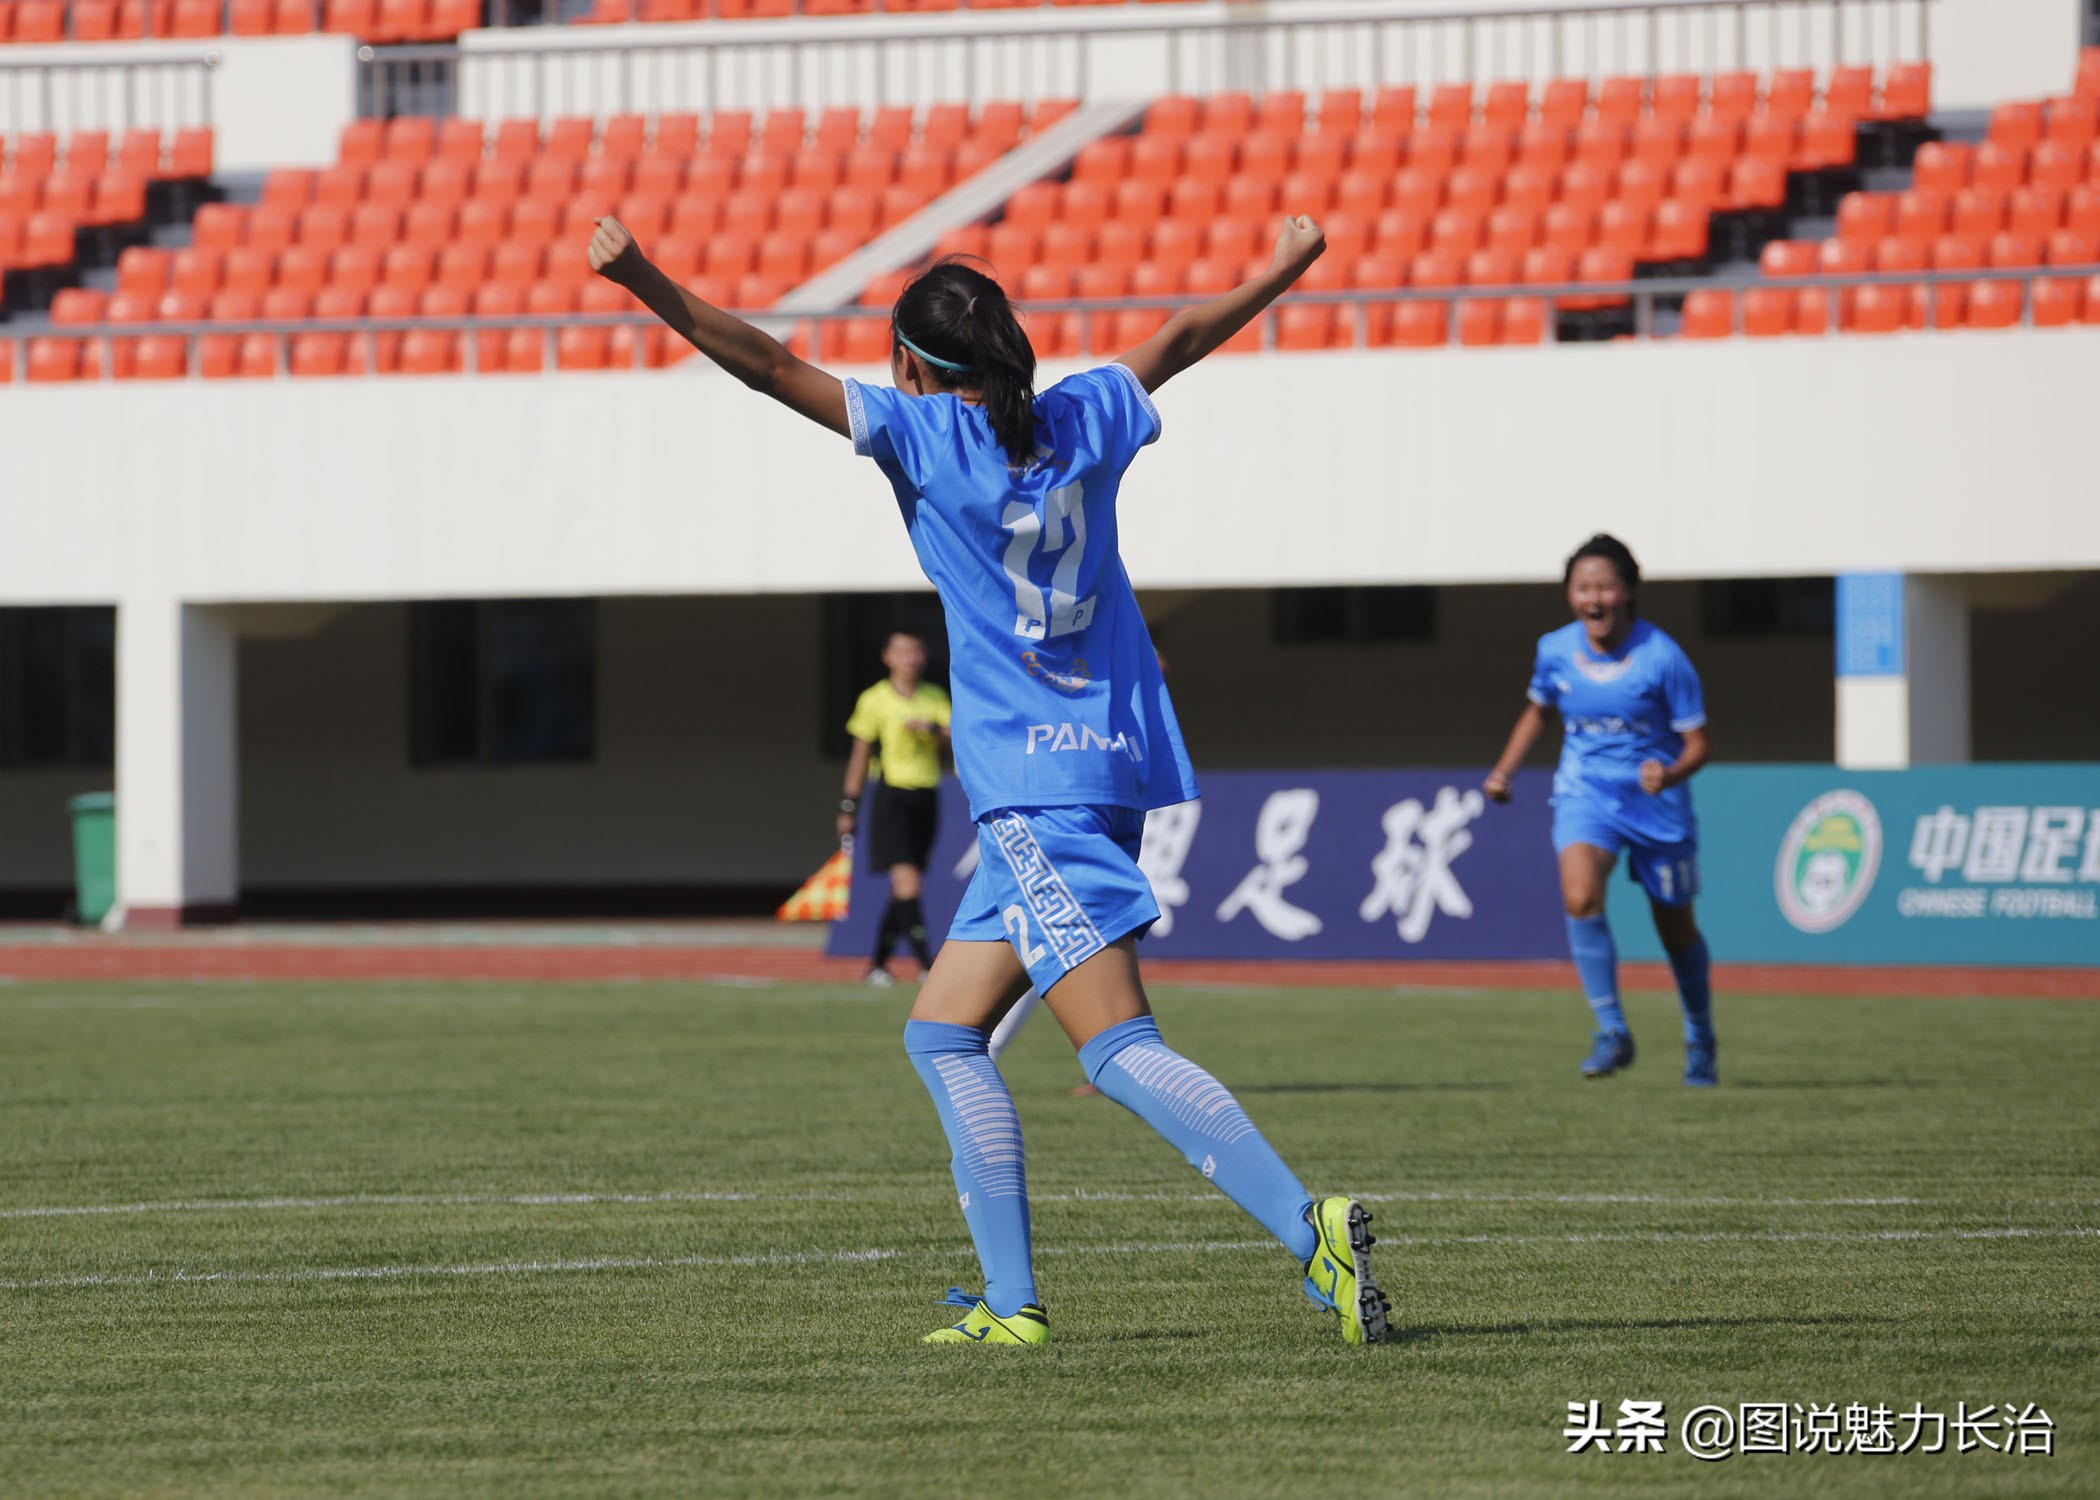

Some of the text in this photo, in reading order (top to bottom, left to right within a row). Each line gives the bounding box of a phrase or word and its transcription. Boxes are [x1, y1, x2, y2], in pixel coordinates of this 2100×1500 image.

[1025, 722, 1144, 763] PAN
[1908, 804, 2100, 883] 中国足
[1897, 887, 2099, 920] CHINESE FOOTBALL
[1003, 903, 1046, 970] 2
